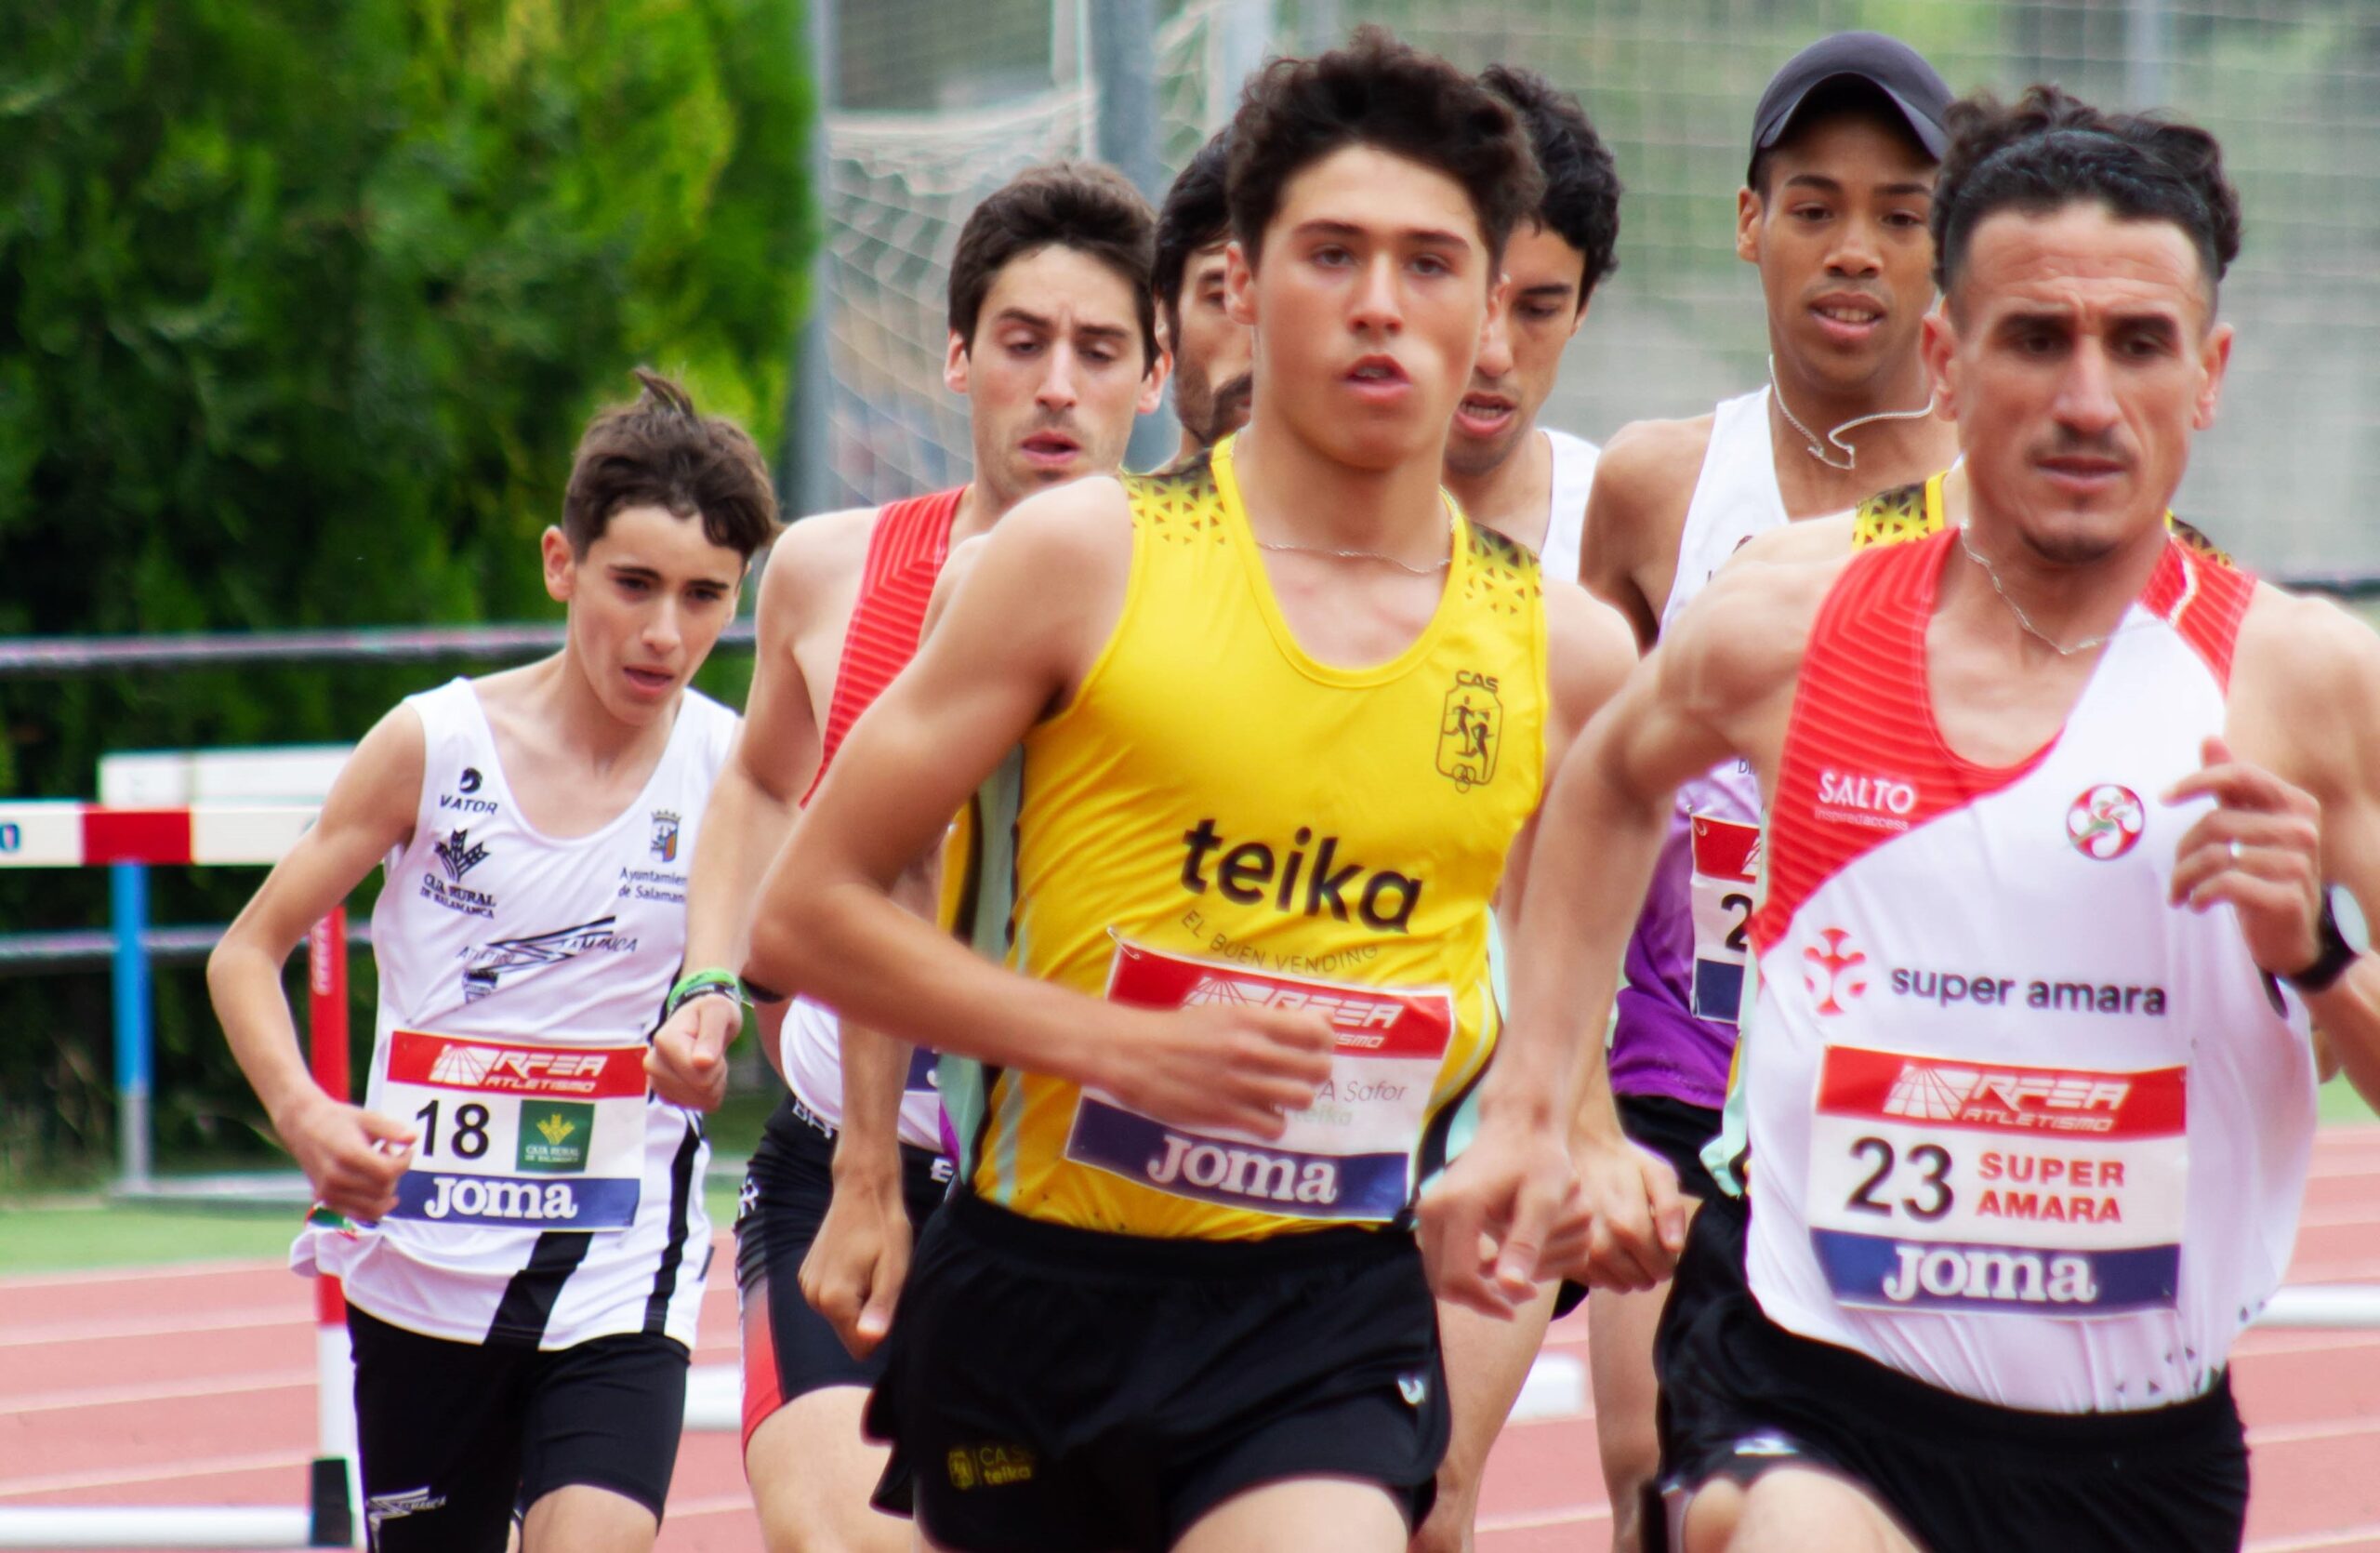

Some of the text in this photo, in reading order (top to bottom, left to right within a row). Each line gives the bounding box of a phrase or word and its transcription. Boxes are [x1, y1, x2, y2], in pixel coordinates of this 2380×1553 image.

[1455, 670, 1500, 693] CAS
[440, 793, 499, 816] VATOR
[1818, 770, 1916, 815] SALTO
[1180, 817, 1423, 935] teika
[1182, 909, 1379, 974] EL BUEN VENDING
[1891, 965, 2168, 1016] super amara
[484, 1074, 597, 1093] ATLETISMO
[493, 1051, 608, 1080] RFEA
[1343, 1080, 1409, 1103] Safor
[1973, 1073, 2132, 1112] RFEA
[416, 1099, 491, 1161] 18
[1961, 1107, 2115, 1133] ATLETISMO
[1844, 1135, 1955, 1224] 23
[1977, 1151, 2125, 1188] SUPER
[1975, 1190, 2123, 1225] AMARA
